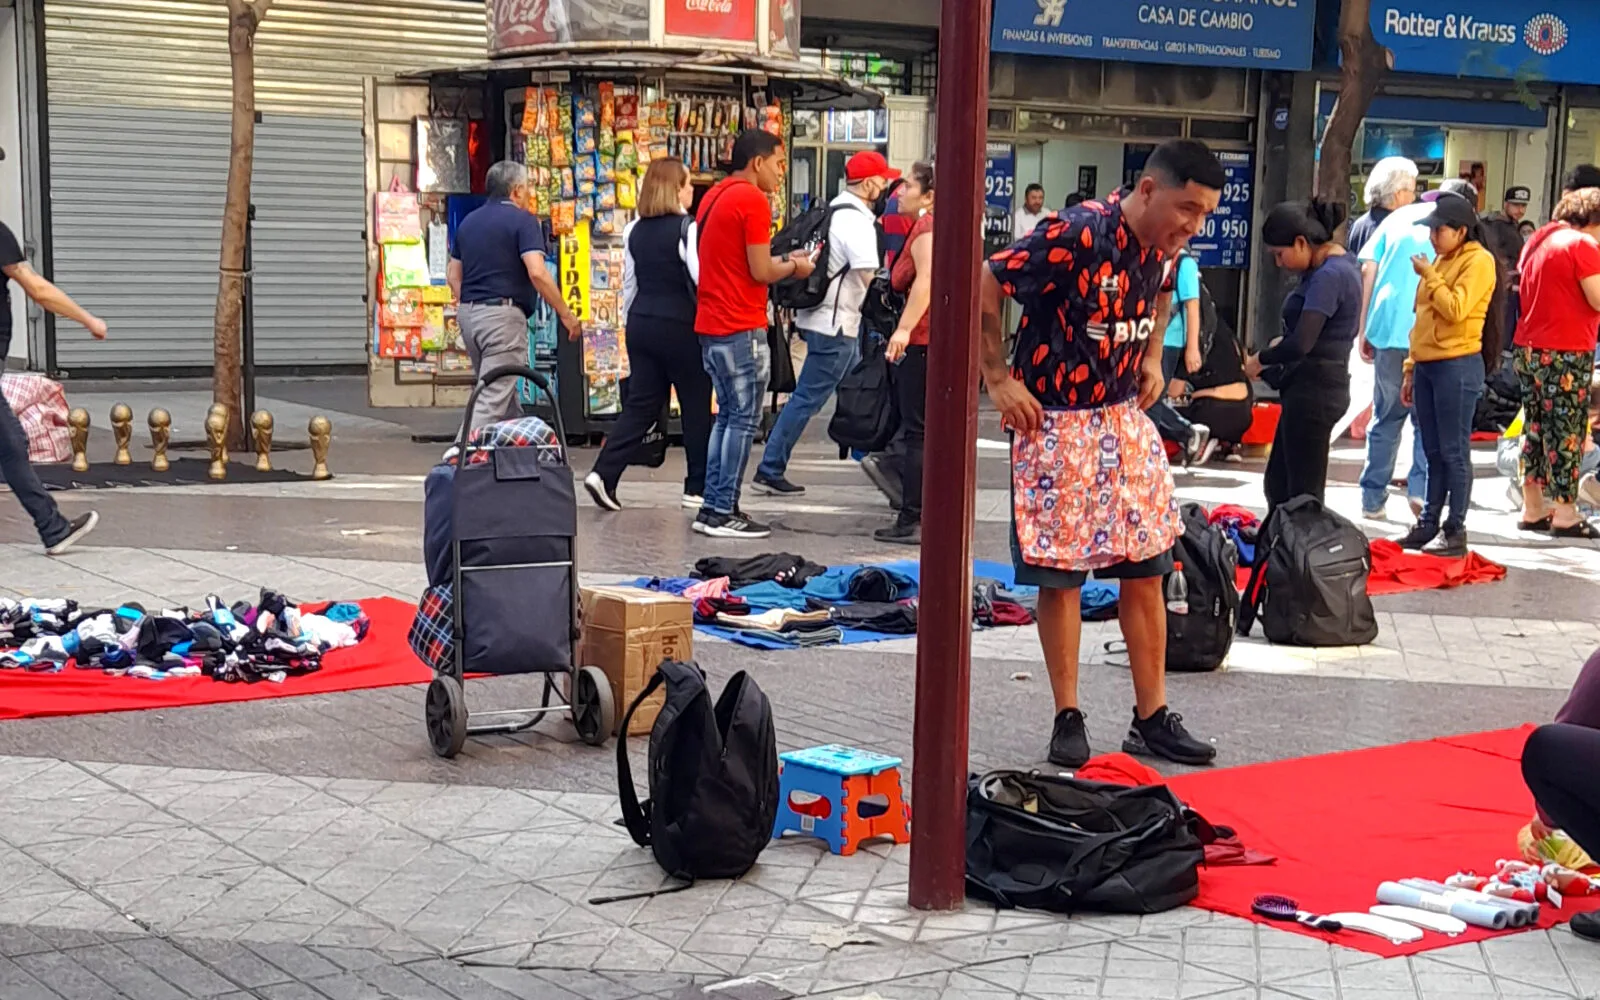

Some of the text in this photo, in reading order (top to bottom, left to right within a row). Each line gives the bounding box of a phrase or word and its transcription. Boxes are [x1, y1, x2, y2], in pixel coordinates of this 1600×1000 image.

[1138, 5, 1253, 31] CASA DE CAMBIO
[1385, 8, 1516, 43] Rotter & Krauss
[1002, 28, 1038, 42] FINANZAS
[1047, 33, 1093, 47] INVERSIONES
[1102, 37, 1159, 50] TRANSFERENCIAS
[1165, 41, 1186, 53] GIROS
[1188, 43, 1246, 57] INTERNACIONALES
[985, 176, 1013, 196] 925
[1223, 183, 1249, 202] 925
[1221, 219, 1248, 238] 950
[565, 235, 582, 317] BIDAS
